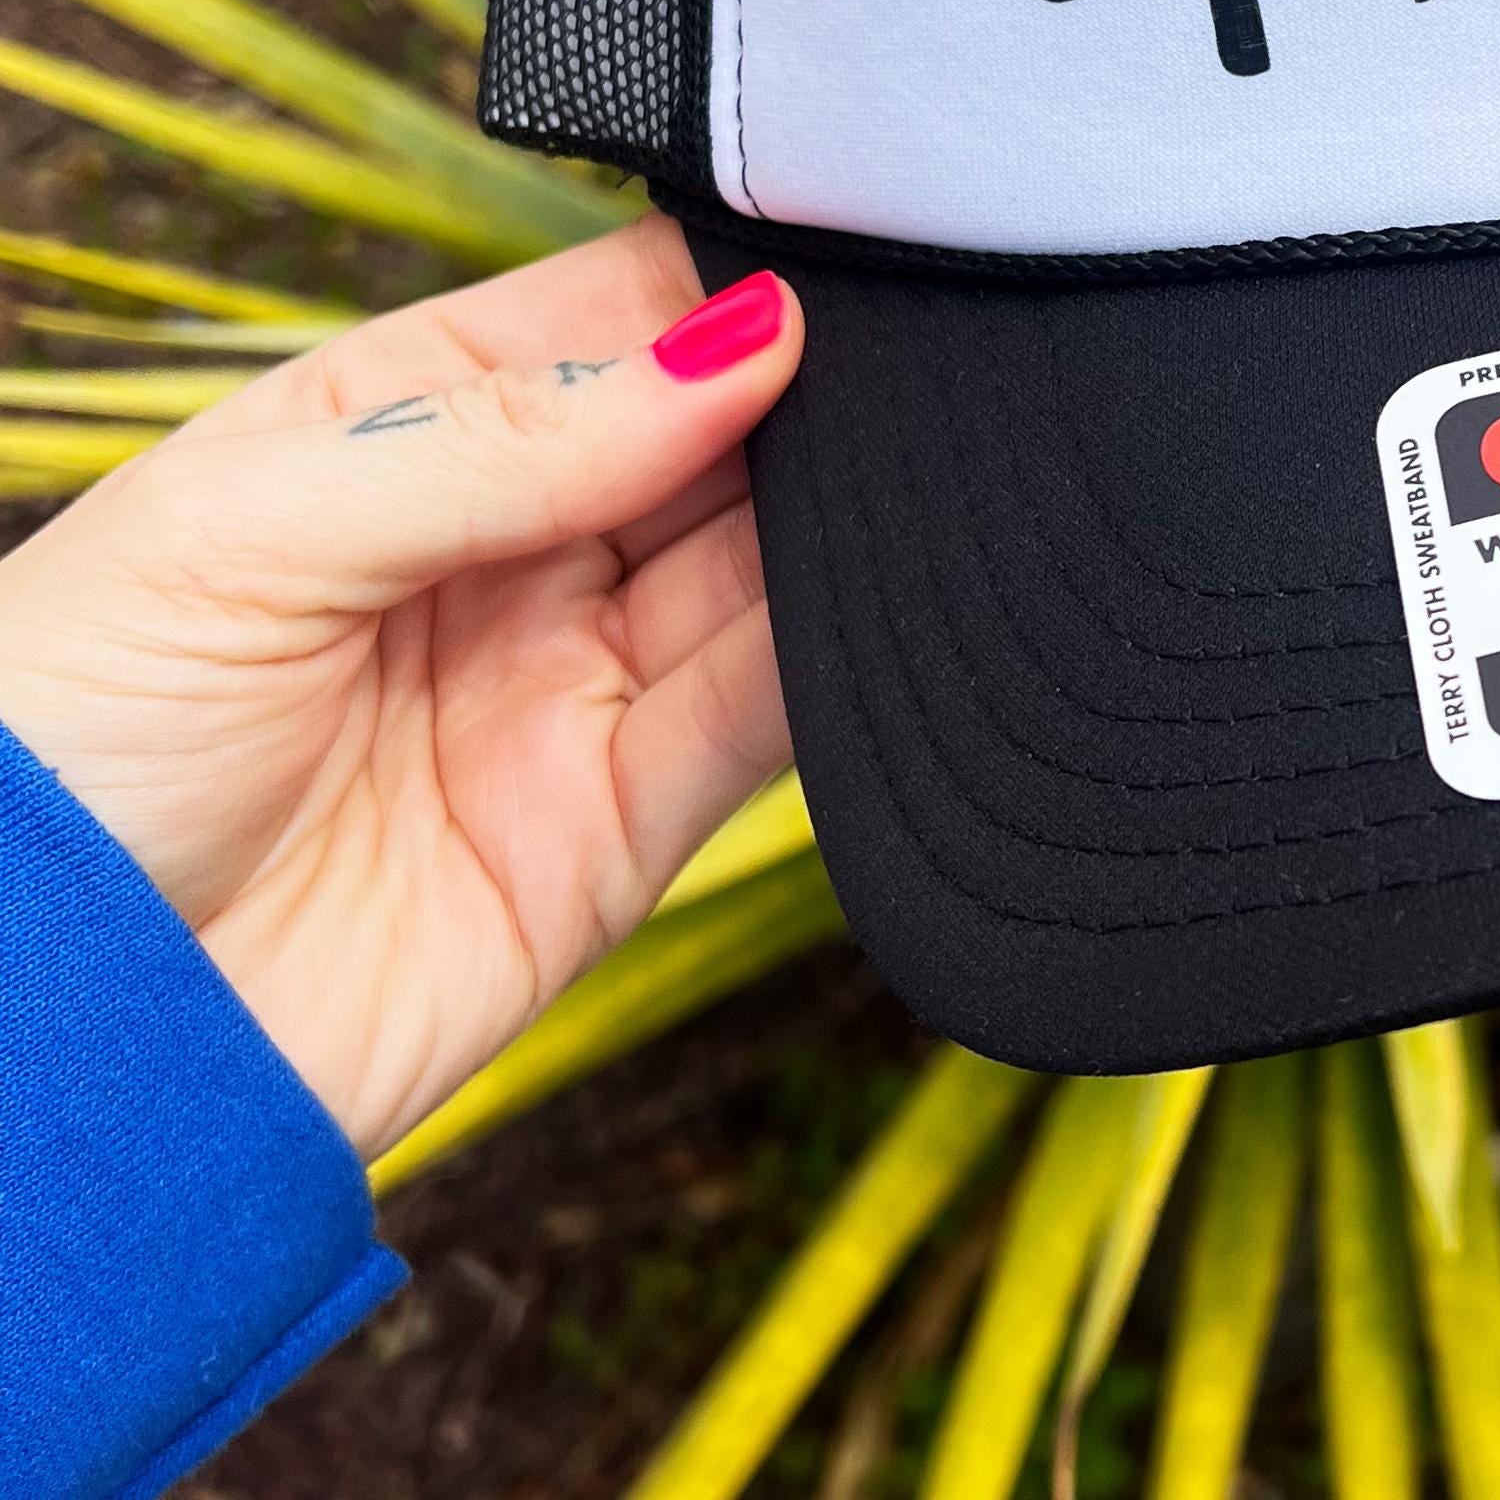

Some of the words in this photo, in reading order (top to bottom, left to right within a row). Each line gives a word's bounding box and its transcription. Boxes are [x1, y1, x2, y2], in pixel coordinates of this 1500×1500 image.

[1398, 438, 1441, 579] SWEATBAND
[1422, 586, 1455, 663] CLOTH
[1438, 671, 1470, 745] TERRY
